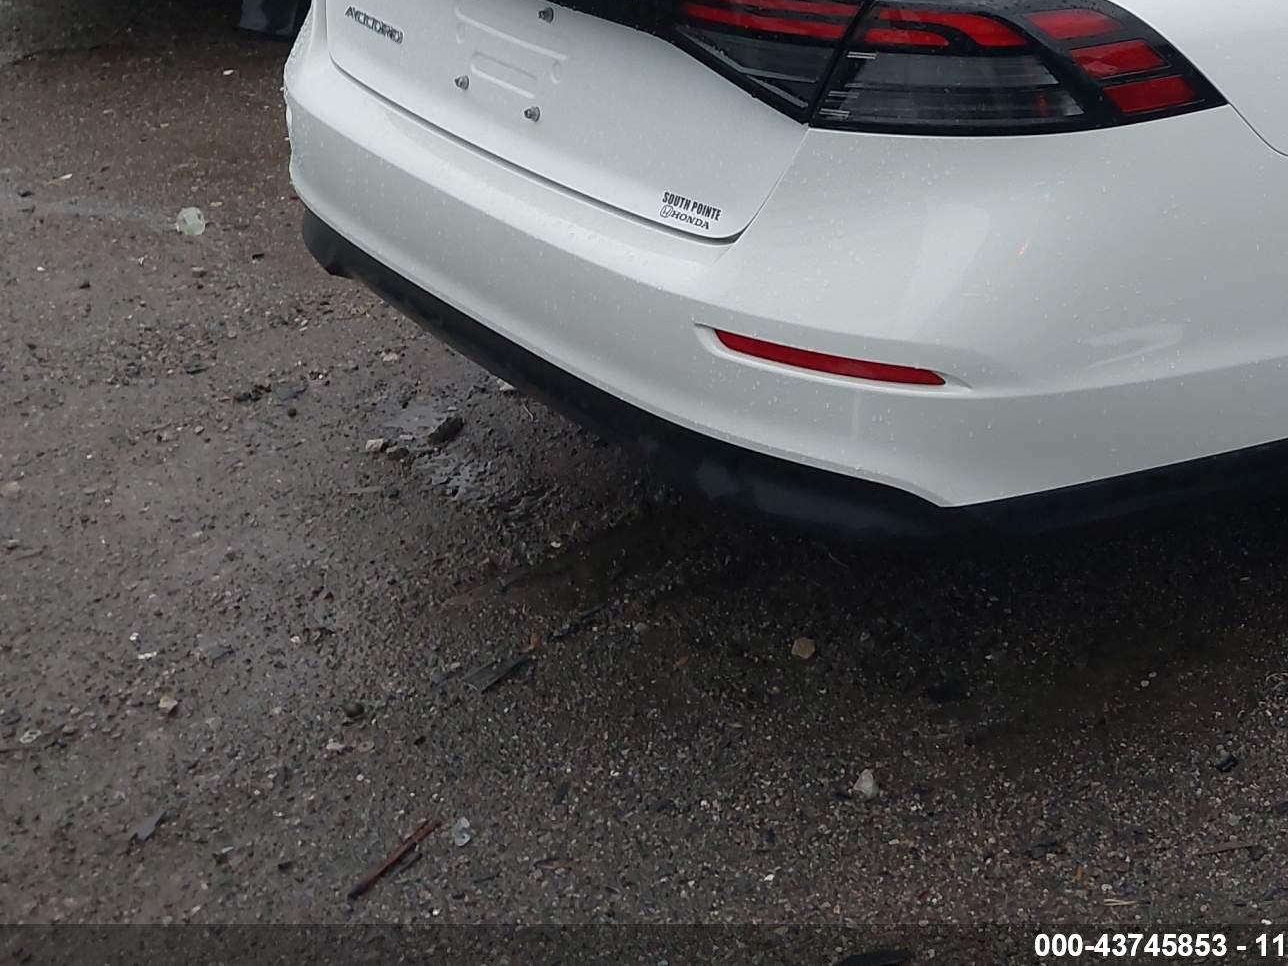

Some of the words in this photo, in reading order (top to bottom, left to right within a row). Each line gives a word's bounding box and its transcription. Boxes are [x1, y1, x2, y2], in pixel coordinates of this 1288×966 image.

[662, 191, 691, 211] SOUTH
[691, 200, 722, 221] POINTE
[671, 210, 710, 230] HONDA
